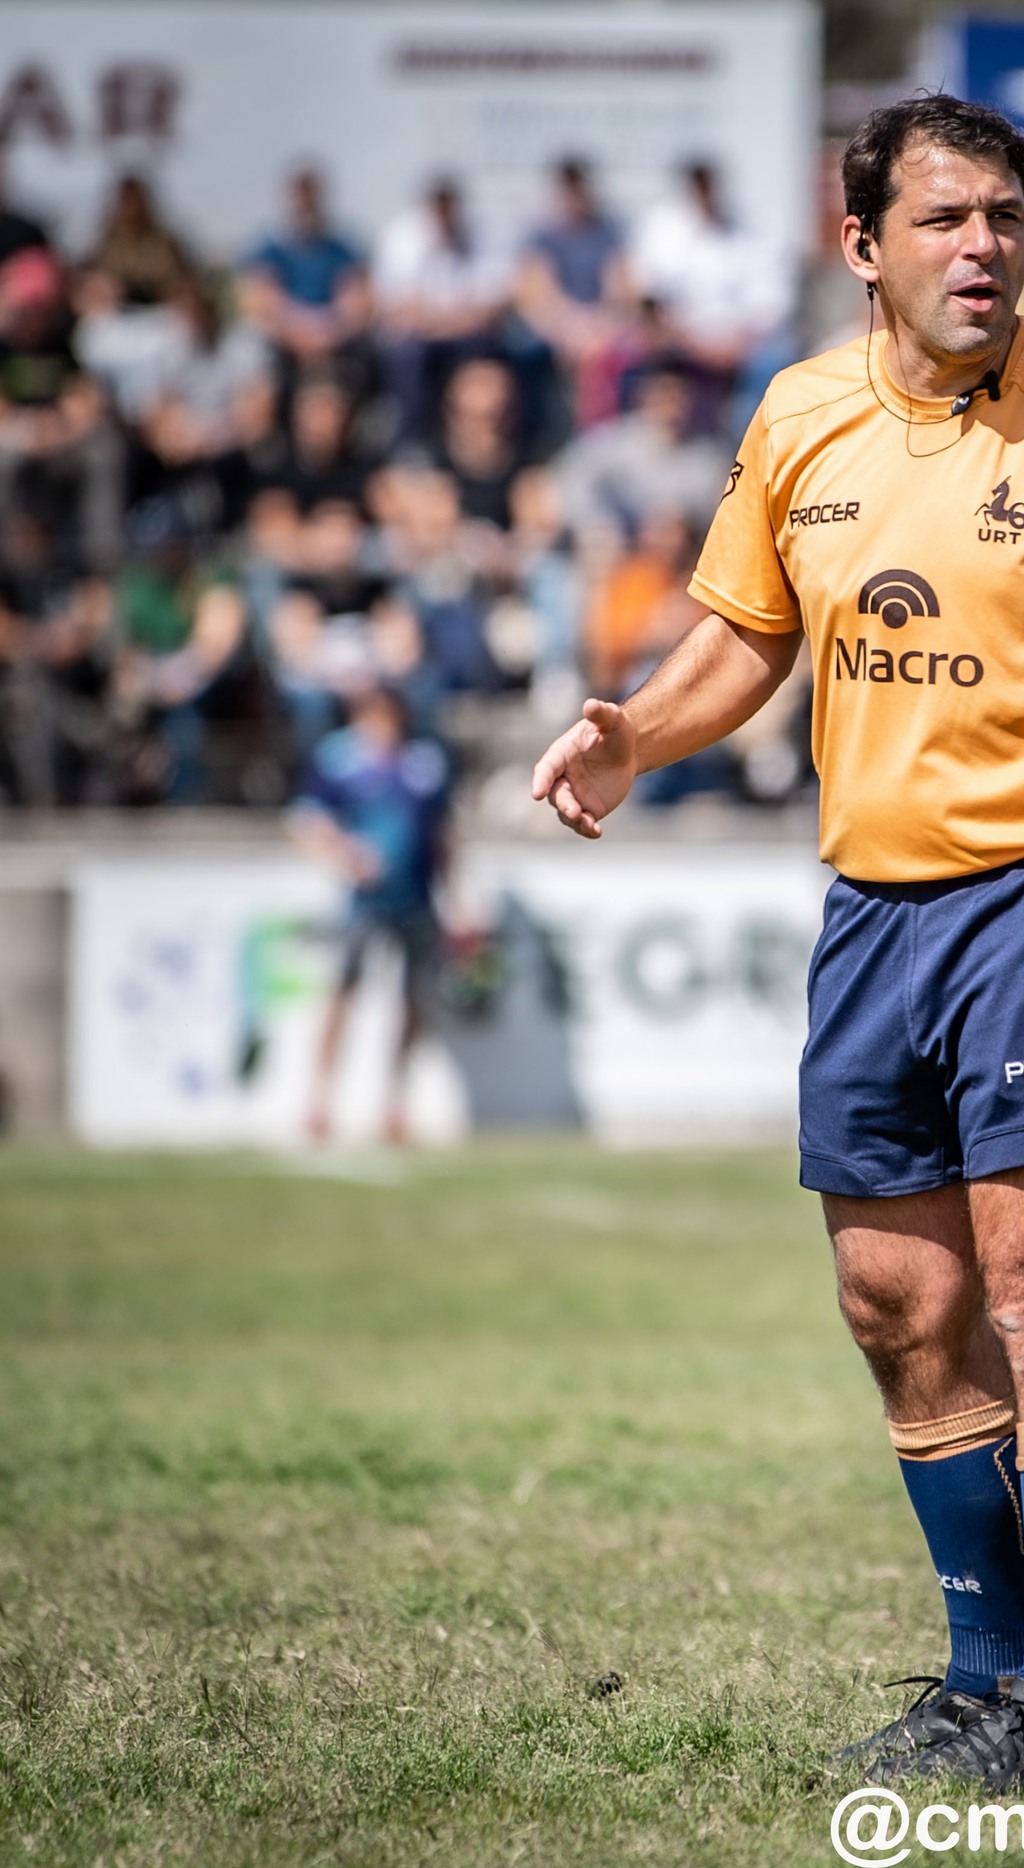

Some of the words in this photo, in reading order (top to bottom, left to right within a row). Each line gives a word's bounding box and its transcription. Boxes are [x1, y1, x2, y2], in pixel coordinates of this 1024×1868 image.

[789, 501, 860, 530] PROCER
[978, 528, 1021, 545] URT
[835, 637, 984, 687] Macro
